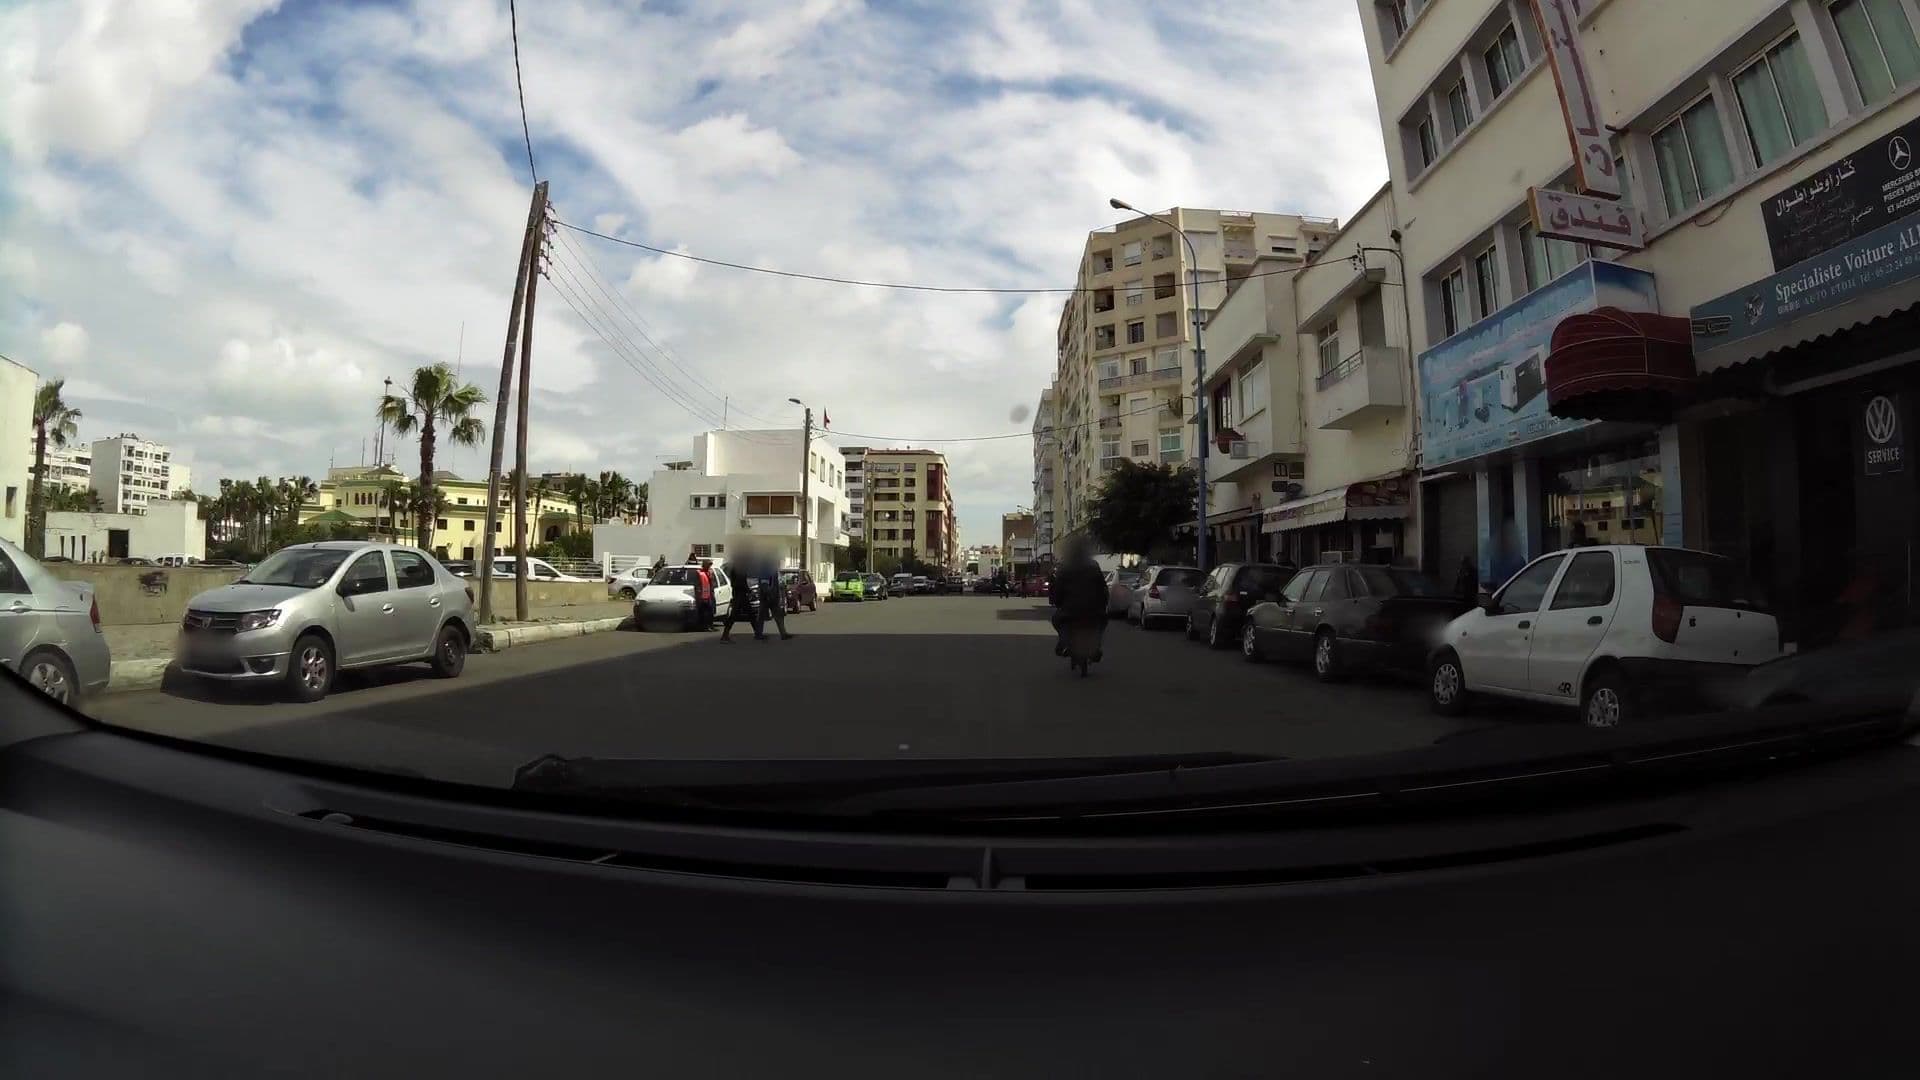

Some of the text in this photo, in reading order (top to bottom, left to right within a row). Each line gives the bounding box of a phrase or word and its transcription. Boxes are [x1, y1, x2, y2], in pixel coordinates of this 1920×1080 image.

[1881, 171, 1914, 192] MERCEDES
[1548, 194, 1632, 237] فندق
[1844, 242, 1894, 273] Voiture
[1867, 447, 1900, 464] SERVICE
